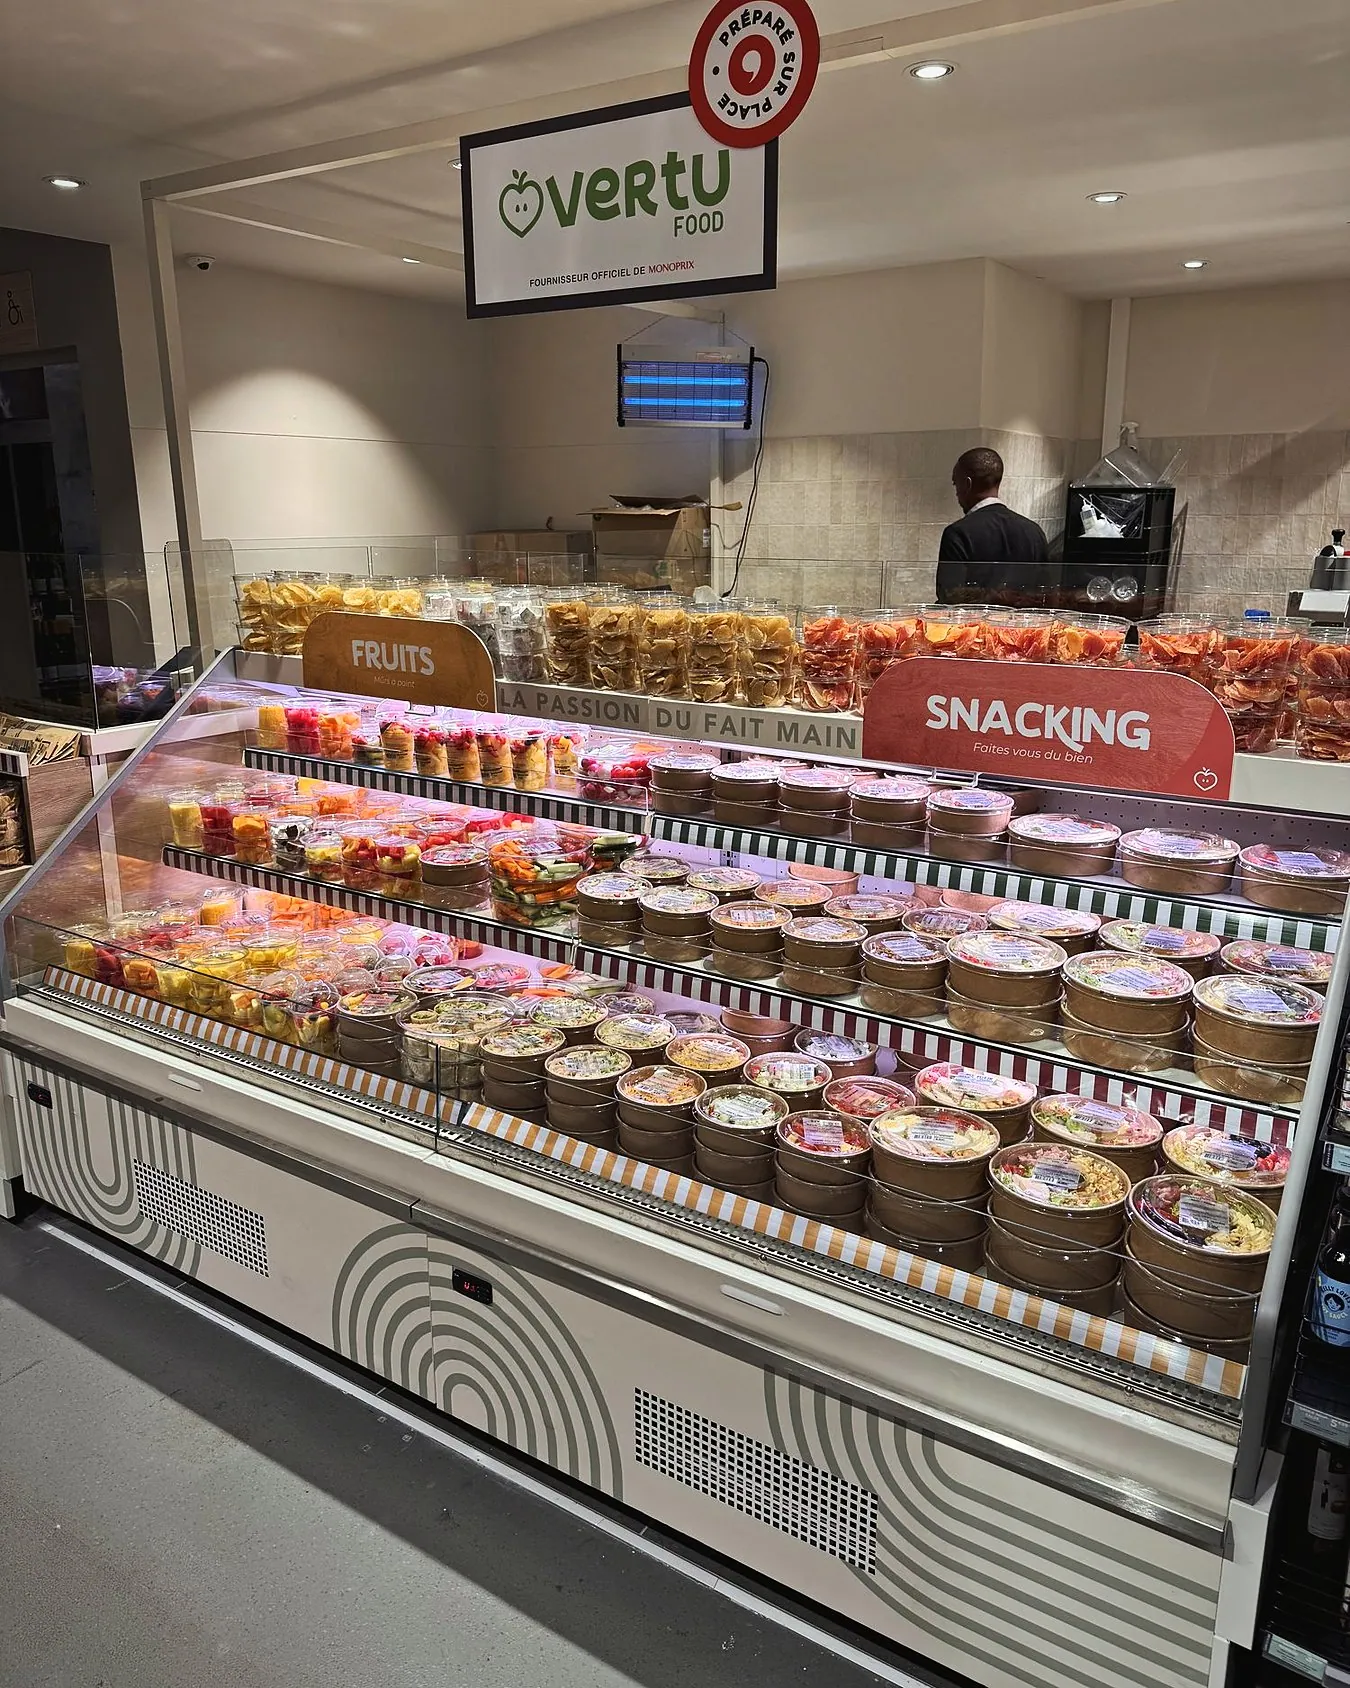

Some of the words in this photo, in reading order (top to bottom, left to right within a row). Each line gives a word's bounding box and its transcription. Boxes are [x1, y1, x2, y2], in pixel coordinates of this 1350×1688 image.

[719, 9, 795, 47] PRÉPARÉ
[773, 52, 796, 96] SUR
[717, 93, 773, 120] PLACE
[674, 210, 724, 238] FOOD
[529, 272, 589, 287] FOURNISSEUR
[591, 267, 631, 281] OFFICIEL
[633, 266, 646, 276] DE
[648, 260, 695, 274] MONOPRIX
[351, 639, 435, 676] FRUITS
[500, 688, 527, 710] LA
[536, 692, 640, 724] PASSION
[656, 707, 691, 731] DU
[704, 713, 764, 739] FAIT
[777, 720, 856, 750] MAIN
[925, 694, 1151, 753] SNACKING
[973, 742, 1010, 756] Faites
[1012, 748, 1041, 760] vous
[1047, 749, 1062, 761] du
[1064, 751, 1093, 764] bien
